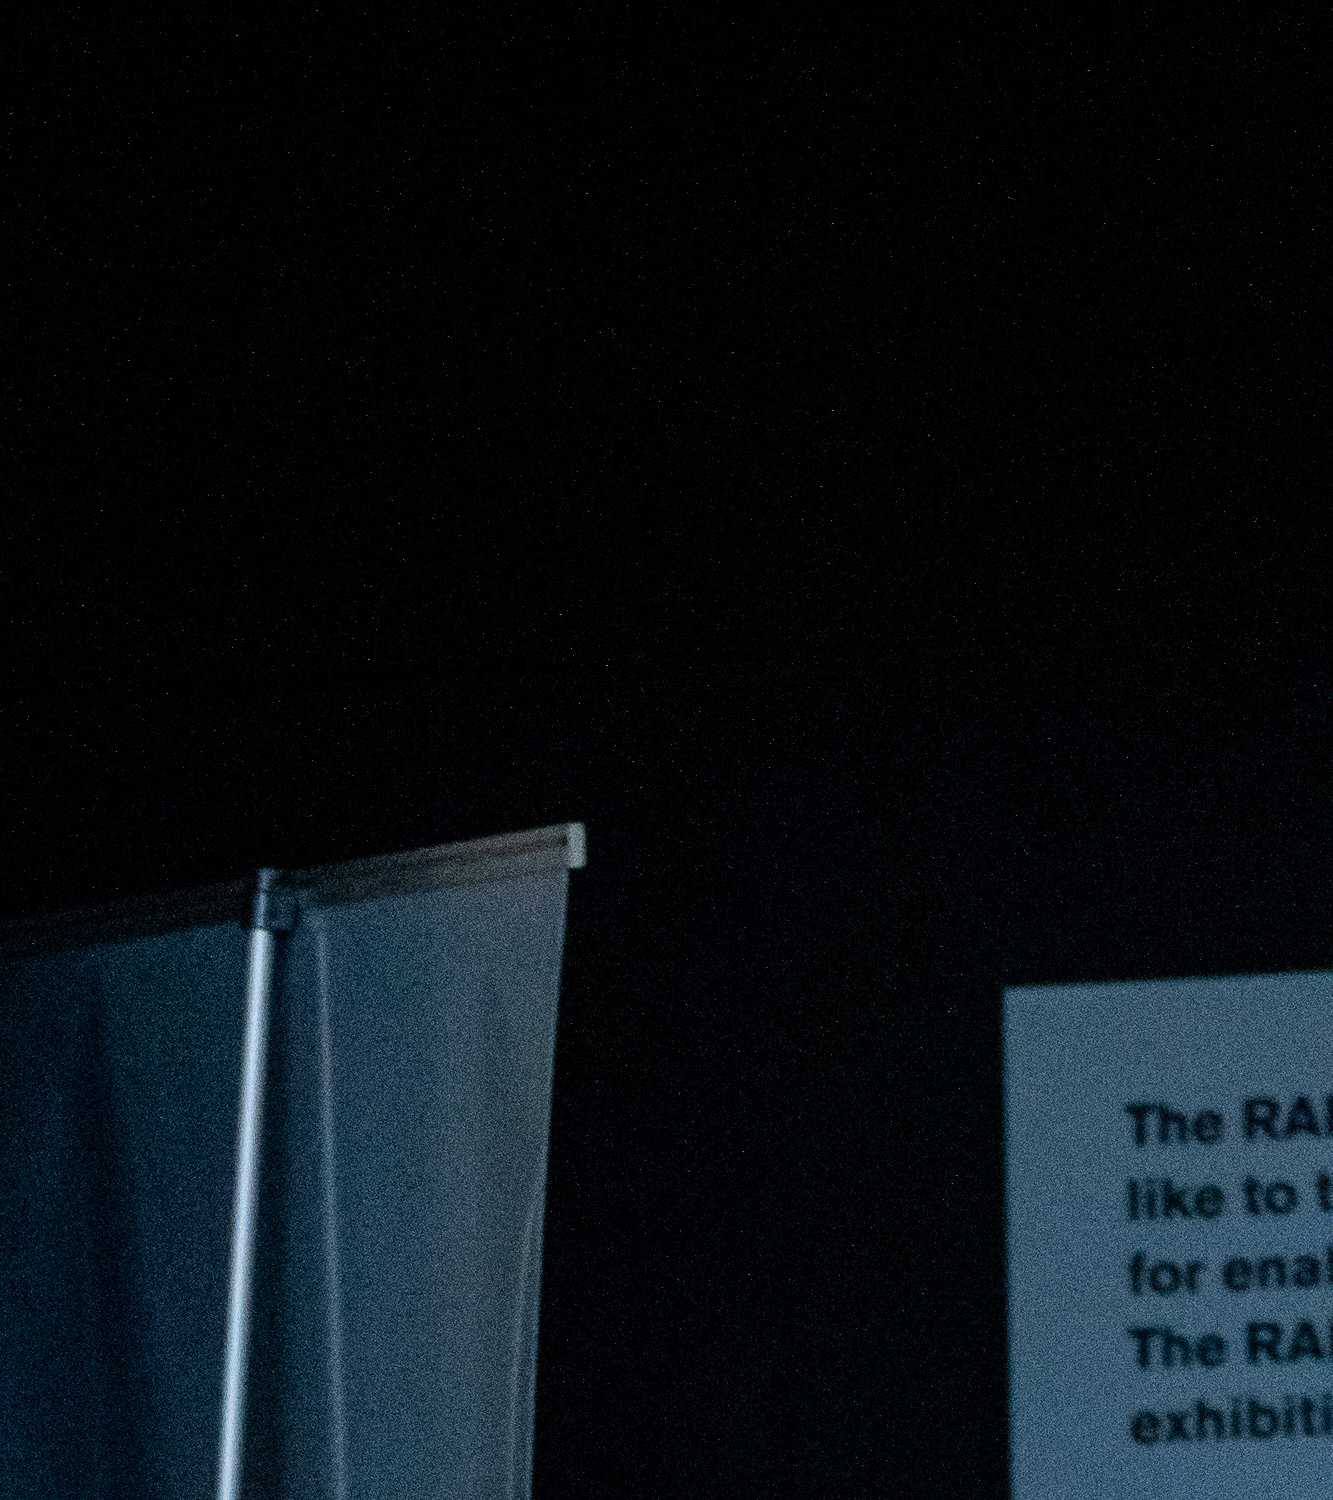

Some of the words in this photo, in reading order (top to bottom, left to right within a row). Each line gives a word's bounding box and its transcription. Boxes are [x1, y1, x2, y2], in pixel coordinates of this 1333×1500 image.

[1125, 1101, 1225, 1145] The
[1127, 1177, 1225, 1220] like
[1242, 1175, 1298, 1216] to
[1129, 1250, 1204, 1297] for
[1127, 1326, 1227, 1370] The
[1245, 1320, 1333, 1365] RA
